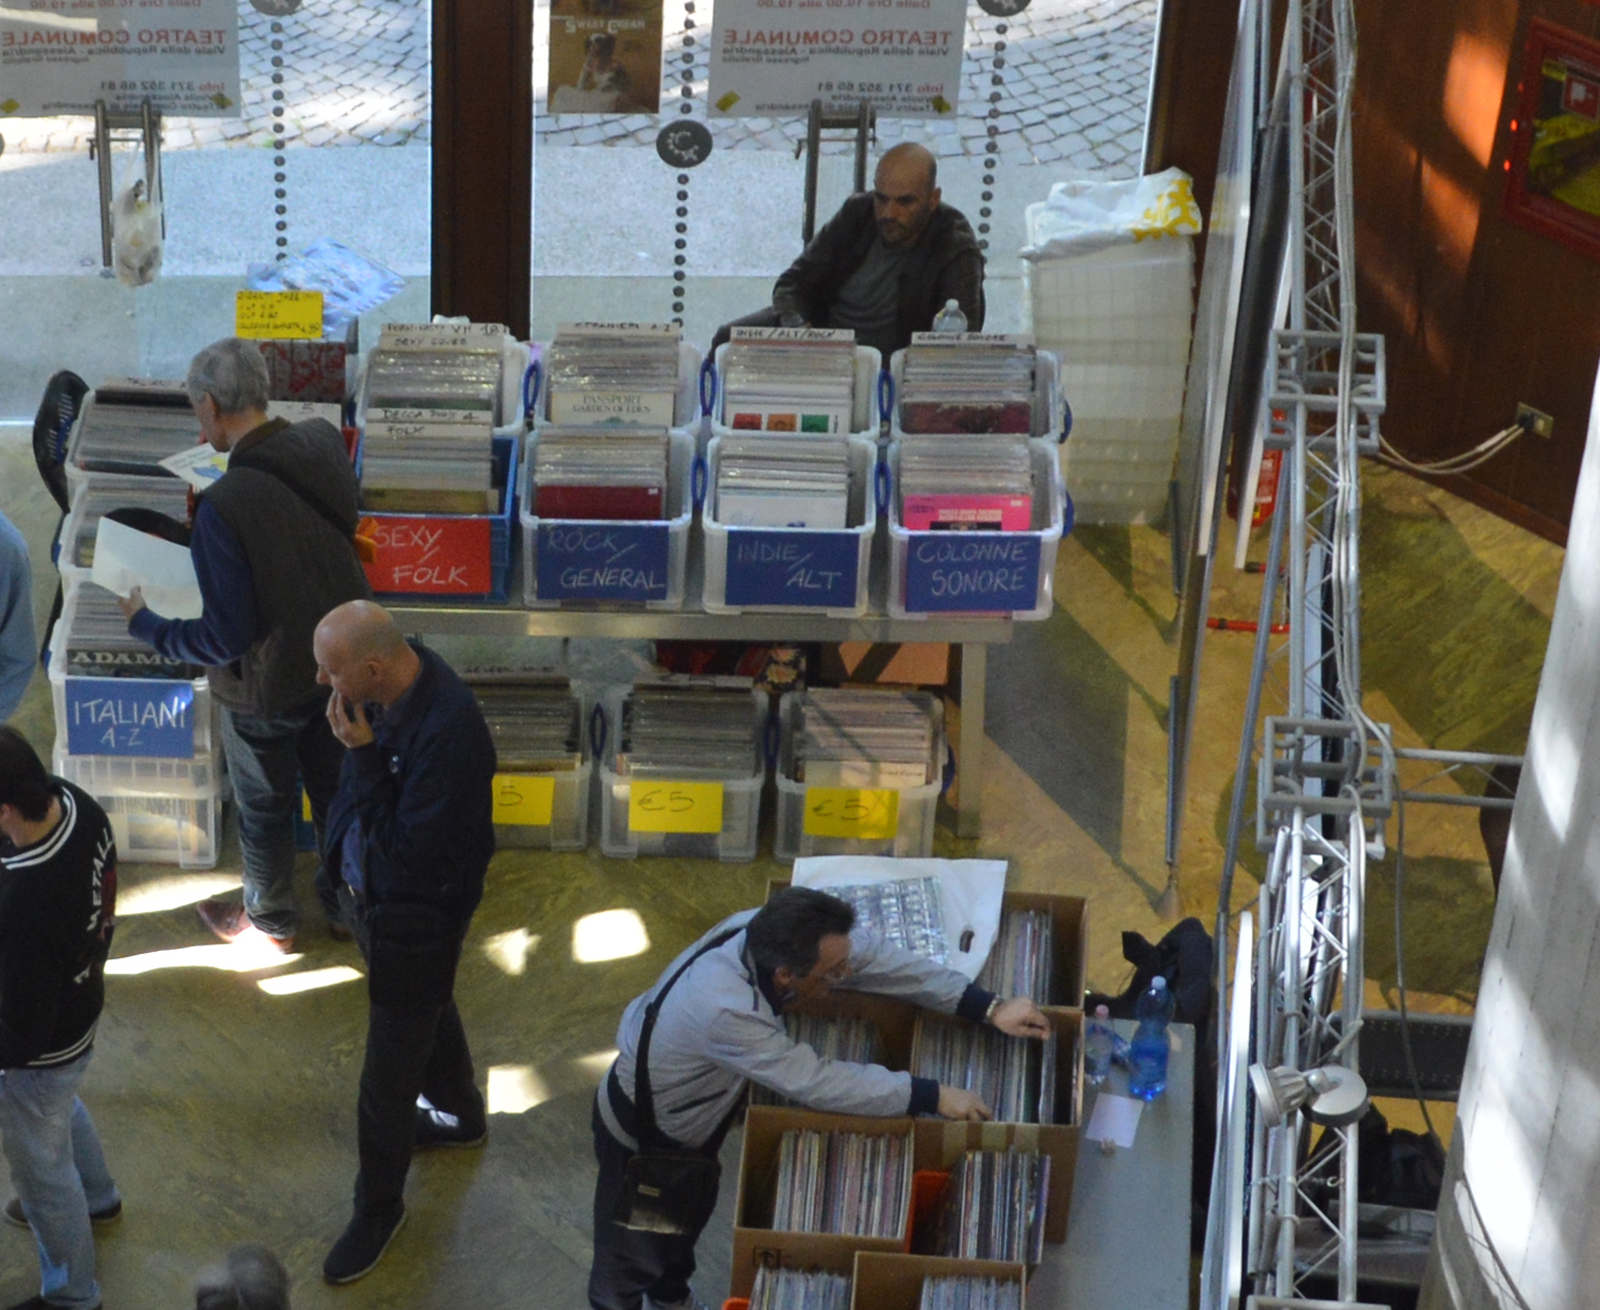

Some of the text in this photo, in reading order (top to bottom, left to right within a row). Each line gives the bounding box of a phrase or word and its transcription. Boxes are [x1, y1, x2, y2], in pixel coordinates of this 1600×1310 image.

[573, 405, 611, 413] GARDEN
[583, 394, 641, 404] PASSPORT
[382, 409, 423, 419] DECCA
[917, 540, 1027, 563] COLONNE
[392, 566, 468, 587] FOLK
[560, 567, 665, 589] GENERAL
[786, 568, 842, 590] ALT
[931, 566, 1026, 596] SONORE
[75, 695, 186, 729] ITALIANI
[101, 728, 143, 748] A-Z
[637, 787, 695, 812] €5
[812, 799, 870, 820] €5
